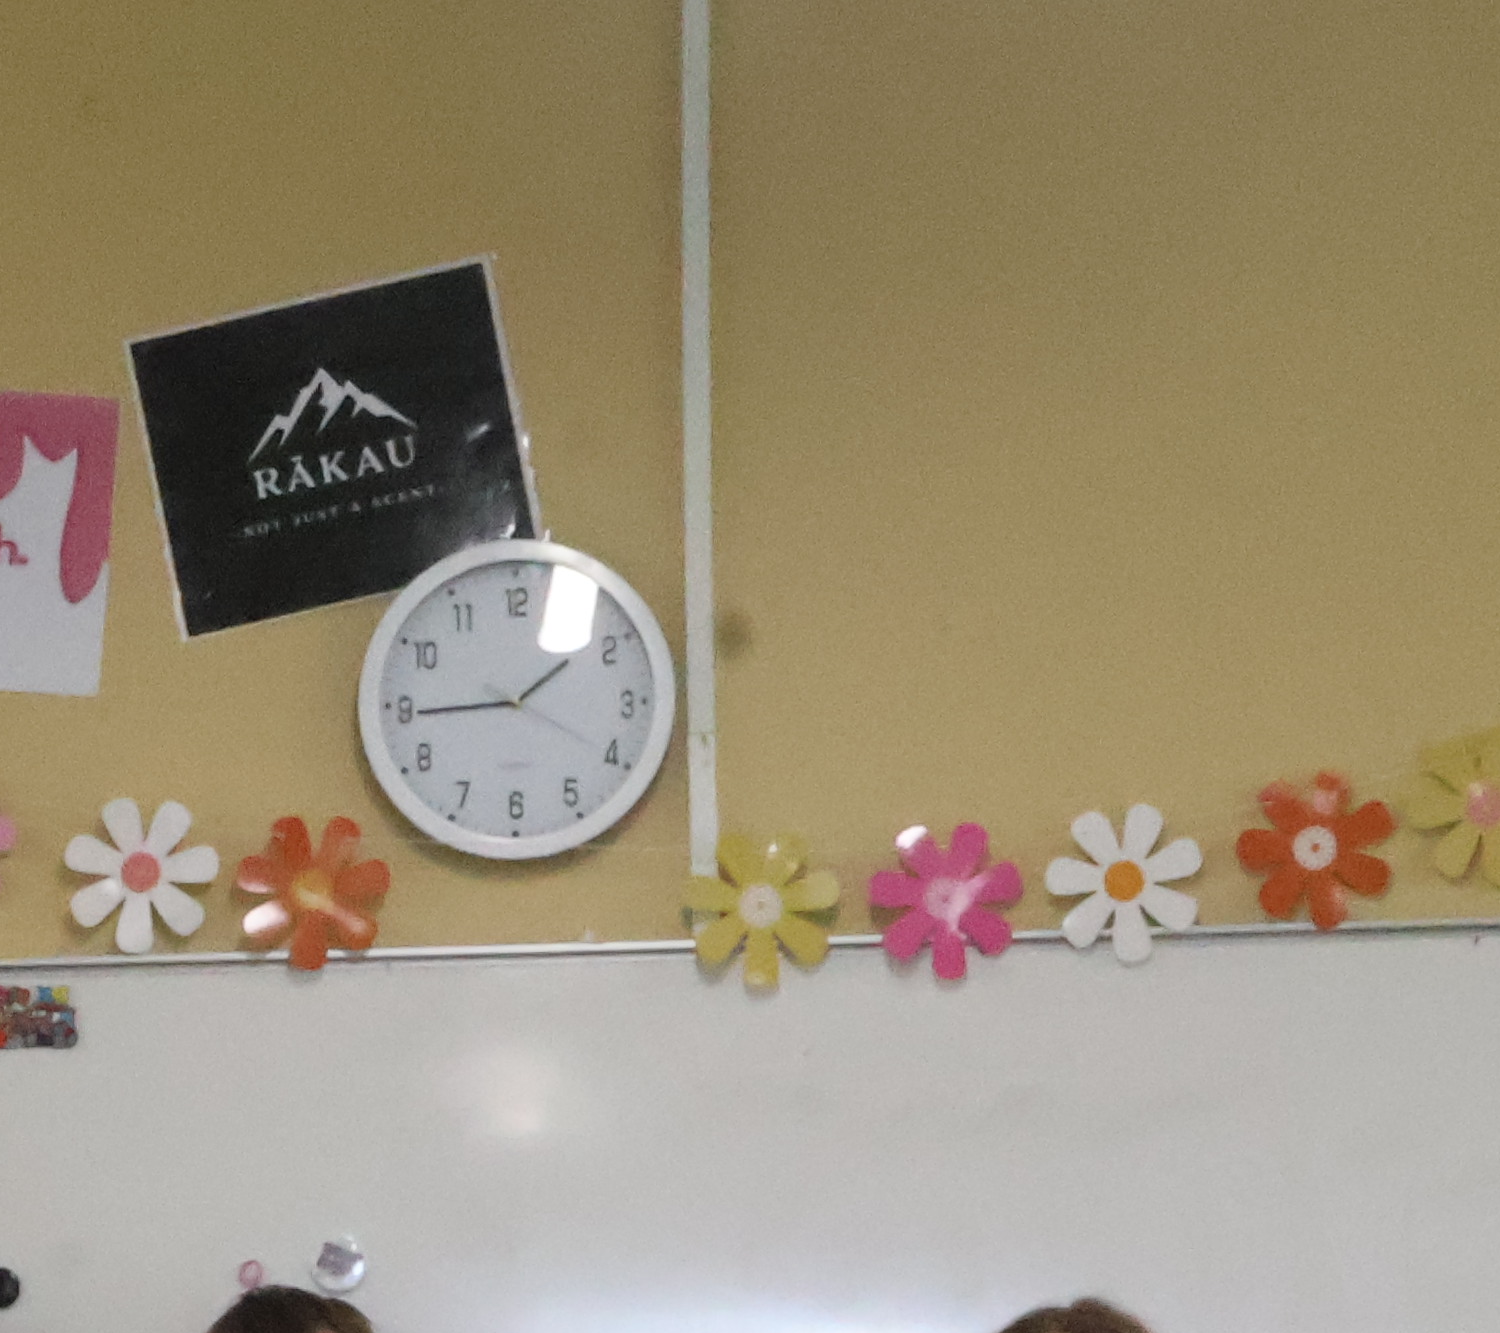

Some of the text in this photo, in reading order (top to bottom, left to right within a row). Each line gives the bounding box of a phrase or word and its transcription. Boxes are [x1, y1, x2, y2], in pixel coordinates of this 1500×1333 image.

[253, 434, 416, 500] RĀKAU
[506, 587, 528, 617] 12
[454, 603, 473, 632] 11
[414, 641, 437, 669] 10
[602, 635, 617, 665] 2
[398, 695, 412, 723] 9
[621, 690, 634, 718] 3
[417, 743, 431, 772] 8
[604, 739, 618, 765] 4
[455, 781, 471, 808] 7
[509, 792, 524, 819] 6
[563, 778, 579, 807] 5
